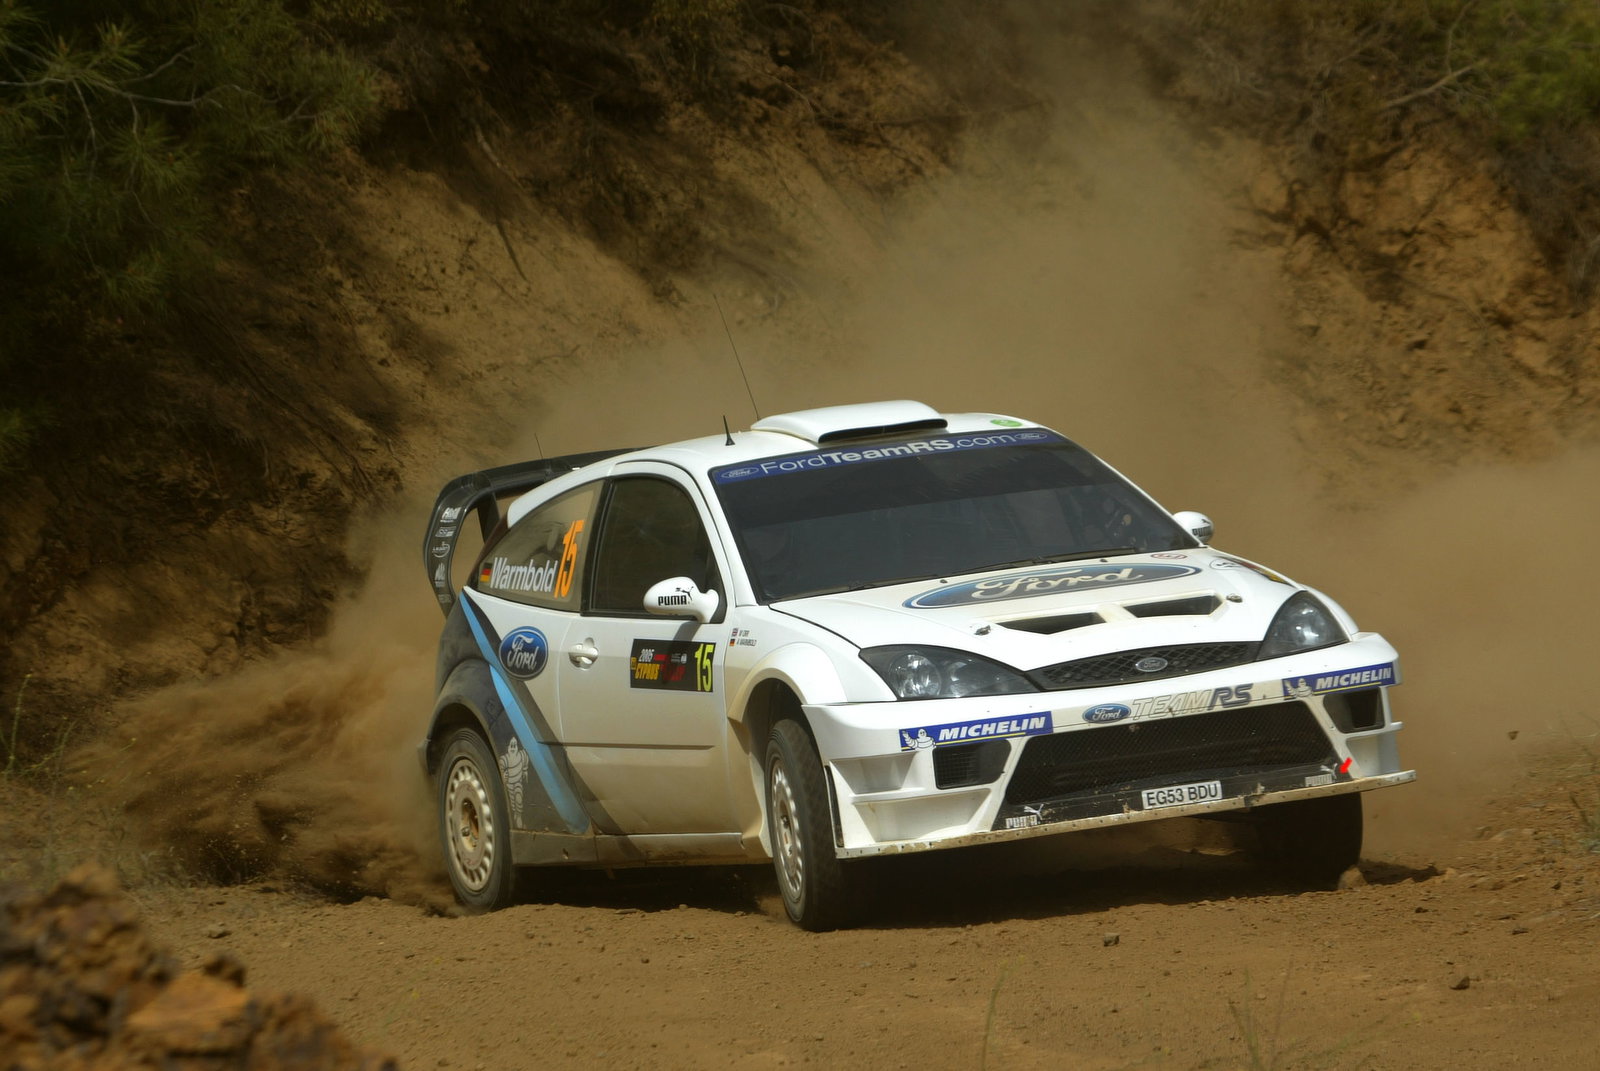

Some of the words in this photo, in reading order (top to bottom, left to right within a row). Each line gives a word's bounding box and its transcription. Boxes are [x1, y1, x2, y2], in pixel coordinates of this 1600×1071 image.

[760, 433, 1017, 474] FordTeamRS.com
[554, 519, 585, 598] 15
[490, 557, 559, 593] Warmbold
[971, 567, 1143, 599] Ford
[658, 595, 687, 606] PUMA
[507, 634, 540, 670] Ford
[635, 663, 660, 680] CYPRUS
[694, 643, 714, 692] 15
[1315, 667, 1392, 690] MICHELIN
[1092, 706, 1122, 721] Ford
[938, 716, 1046, 741] MICHELIN
[1146, 788, 1185, 807] EG53
[1188, 783, 1219, 801] BDU
